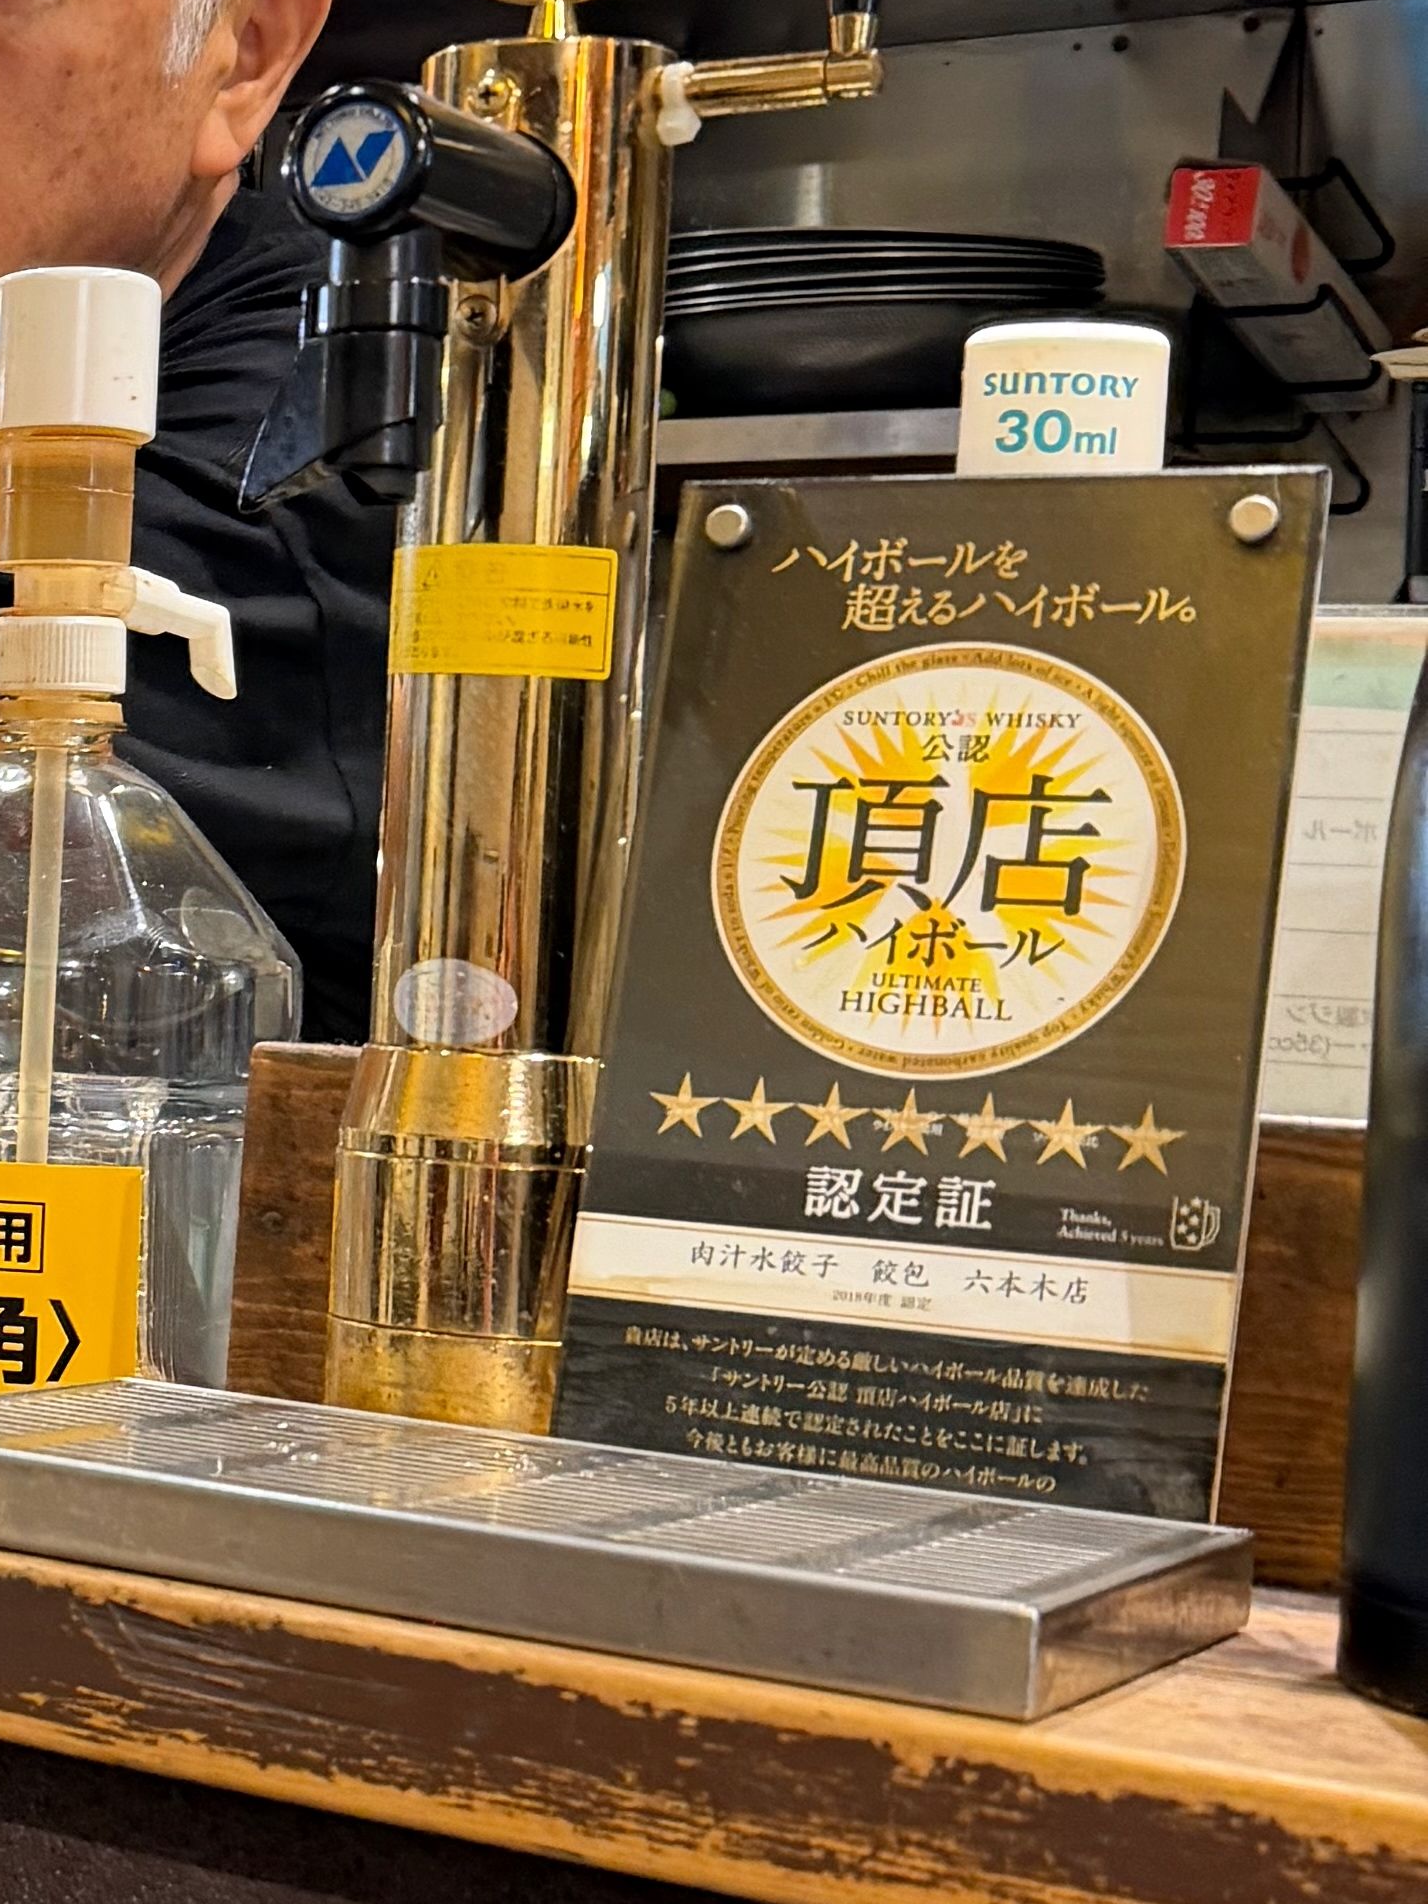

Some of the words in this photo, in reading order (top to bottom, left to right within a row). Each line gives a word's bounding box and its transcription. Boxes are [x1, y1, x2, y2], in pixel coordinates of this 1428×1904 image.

[983, 371, 1140, 398] SUNTORY
[995, 408, 1117, 456] 30ml
[771, 537, 1029, 582] ハイボールを
[841, 582, 1197, 632] 超えるハイボール。
[974, 651, 1003, 667] Add
[853, 664, 893, 690] Chill
[986, 711, 1082, 729] WHISKY
[922, 732, 991, 764] 公認
[779, 773, 1113, 916] 頂店
[801, 917, 1065, 969] ハイボール
[871, 972, 982, 994] ULTIMATE
[839, 990, 1013, 1022] HIGHBALL
[796, 1016, 847, 1052] Golden
[855, 1045, 898, 1068] water
[803, 1164, 997, 1231] 認定証
[1057, 1224, 1117, 1243] Achieved
[690, 1240, 839, 1279] 肉汁水餃子
[871, 1258, 930, 1289] 餃包
[963, 1268, 1089, 1305] 六本木店
